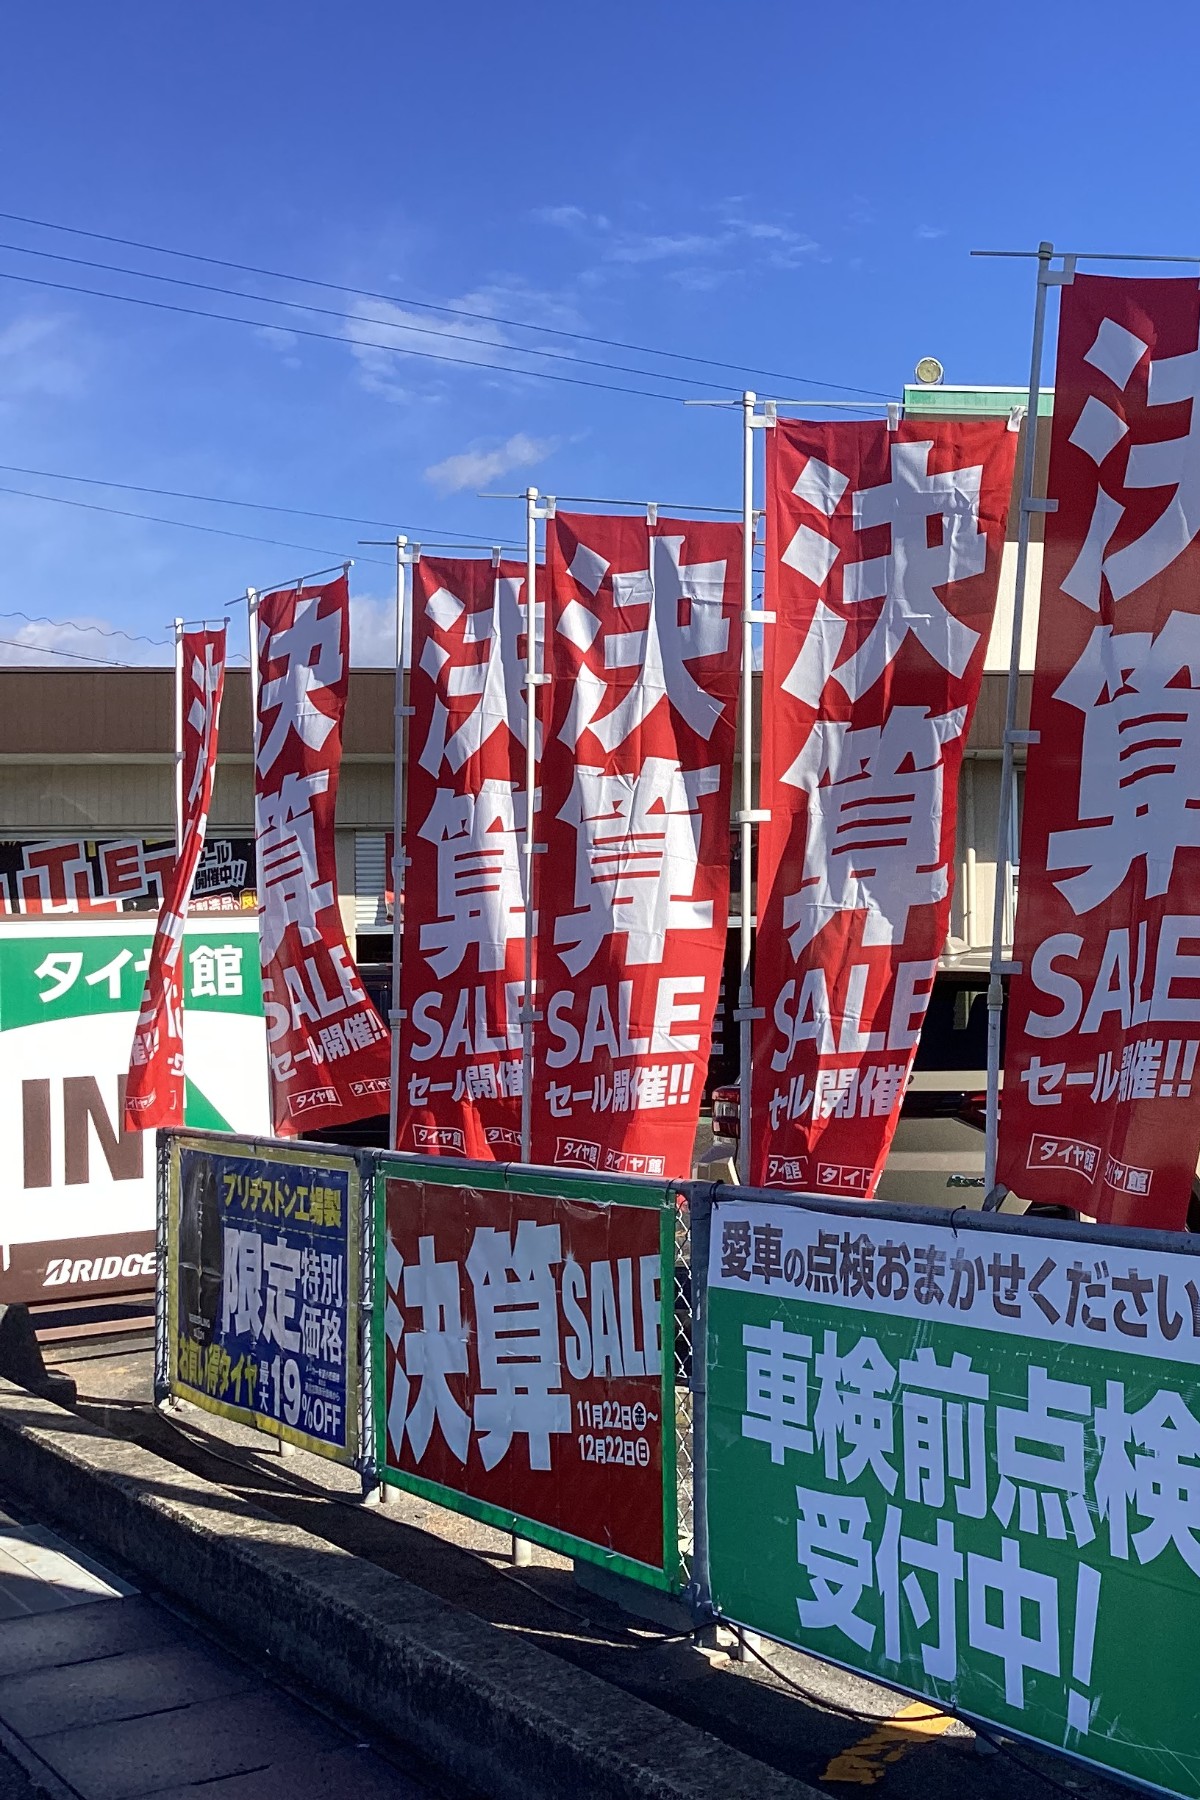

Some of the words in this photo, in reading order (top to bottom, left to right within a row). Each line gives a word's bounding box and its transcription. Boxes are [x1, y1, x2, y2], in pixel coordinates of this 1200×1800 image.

[780, 440, 988, 963] 決算
[418, 578, 544, 980] 決算
[555, 535, 731, 978] 決算
[261, 944, 367, 1043] SALE
[410, 980, 537, 1062] SALE
[546, 976, 706, 1069] SALE
[770, 958, 940, 1073] SALE
[271, 1008, 388, 1083] セール開催!!
[354, 1078, 391, 1094] タイヤ
[408, 1057, 535, 1107] セール開催
[22, 1073, 144, 1189] IN
[296, 1089, 336, 1109] タイヤ館
[545, 1063, 695, 1118] セール開催!!
[418, 1130, 462, 1148] タイヤ館
[563, 1142, 598, 1164] タイヤ館
[605, 1150, 663, 1174] タイヤ館
[1040, 1141, 1096, 1173] タイヤ館
[223, 1173, 342, 1229] ブリヂストン工場製
[222, 1226, 302, 1352] 限定
[300, 1246, 343, 1309] 特別
[299, 1303, 343, 1366] 価格
[385, 1220, 573, 1473] 決算
[561, 1253, 663, 1381] SALE
[179, 1331, 258, 1407] お買い得タイヤ
[271, 1354, 301, 1427] 19
[301, 1392, 342, 1437] %OFF
[795, 1484, 1102, 1736] 受付中!
